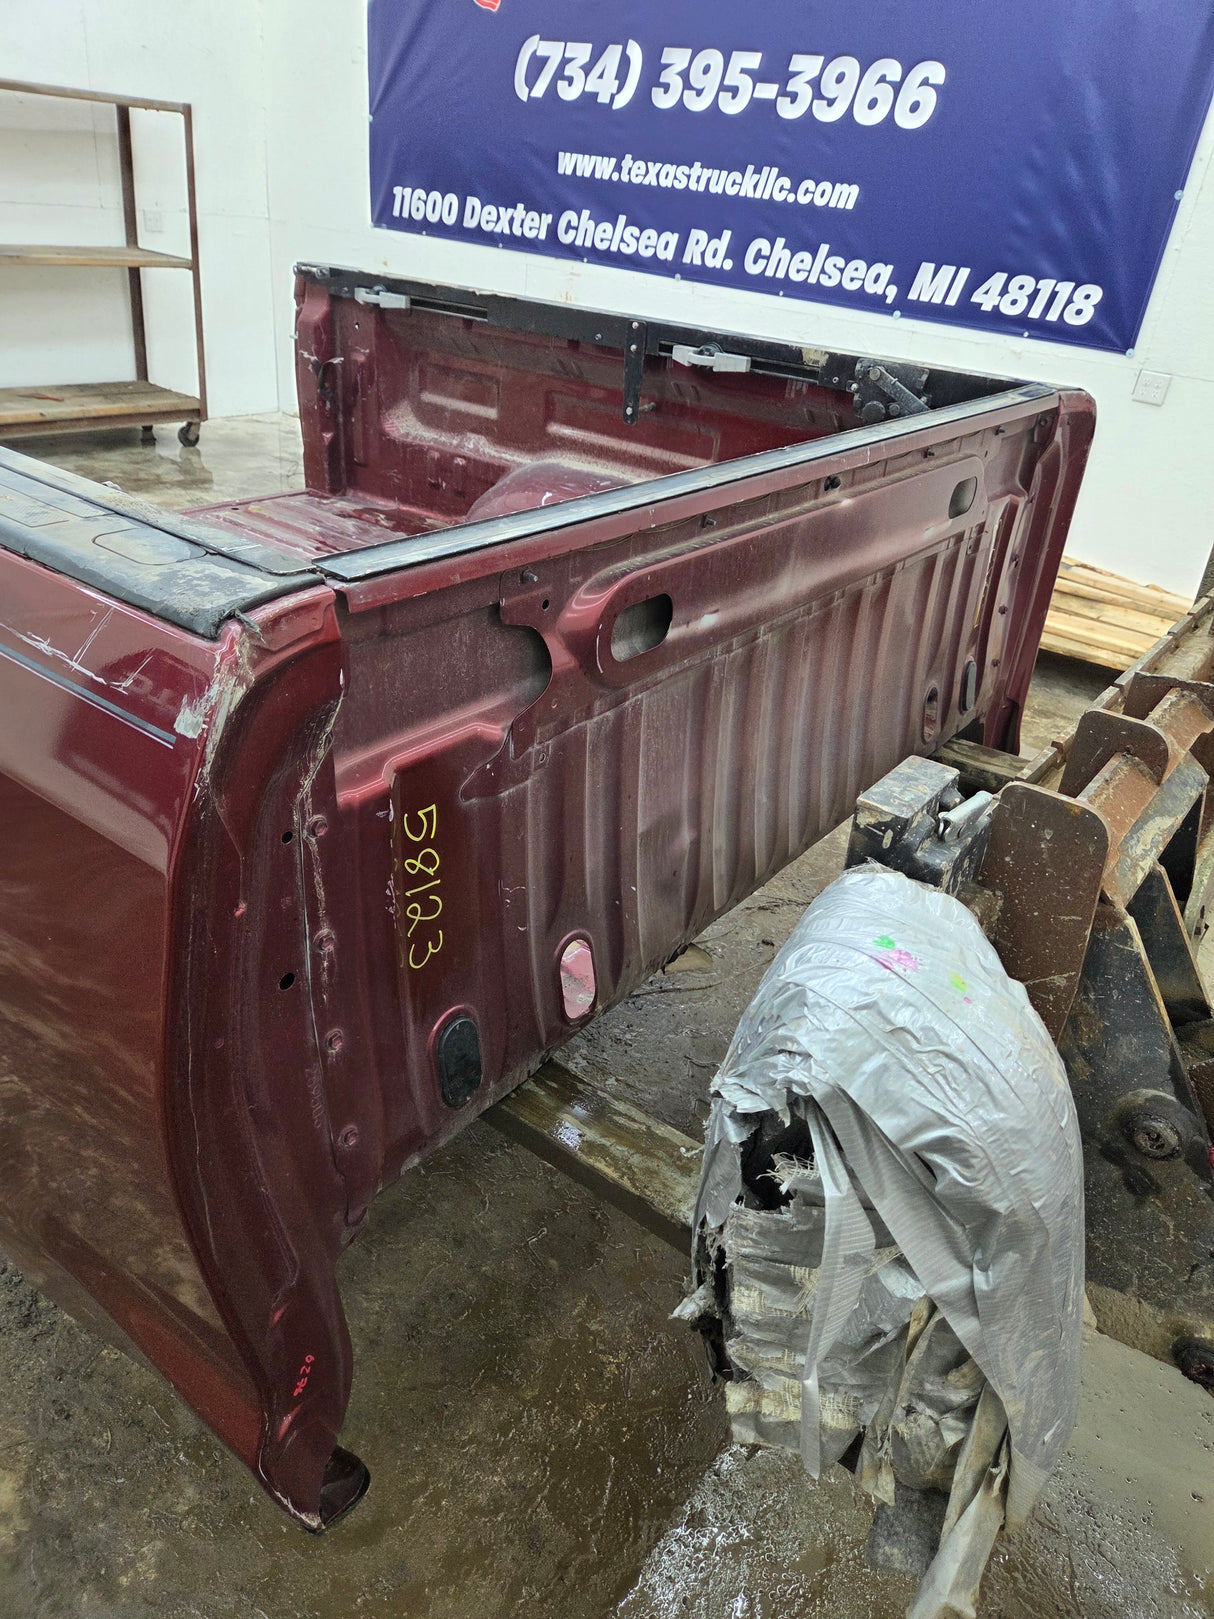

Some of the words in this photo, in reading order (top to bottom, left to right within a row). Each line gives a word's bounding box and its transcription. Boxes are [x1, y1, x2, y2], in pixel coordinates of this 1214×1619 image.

[514, 34, 643, 110] (734)
[651, 46, 946, 130] 395-3966
[557, 151, 860, 210] www.texastruckllc.com
[392, 185, 459, 226] 11600
[462, 196, 553, 241] Dexter
[557, 210, 680, 262] Chelsea
[682, 228, 734, 271] Rd.
[744, 237, 898, 305] Chelsea,
[907, 261, 971, 307] MI
[970, 271, 1104, 326] 48118
[403, 803, 443, 969] 58123
